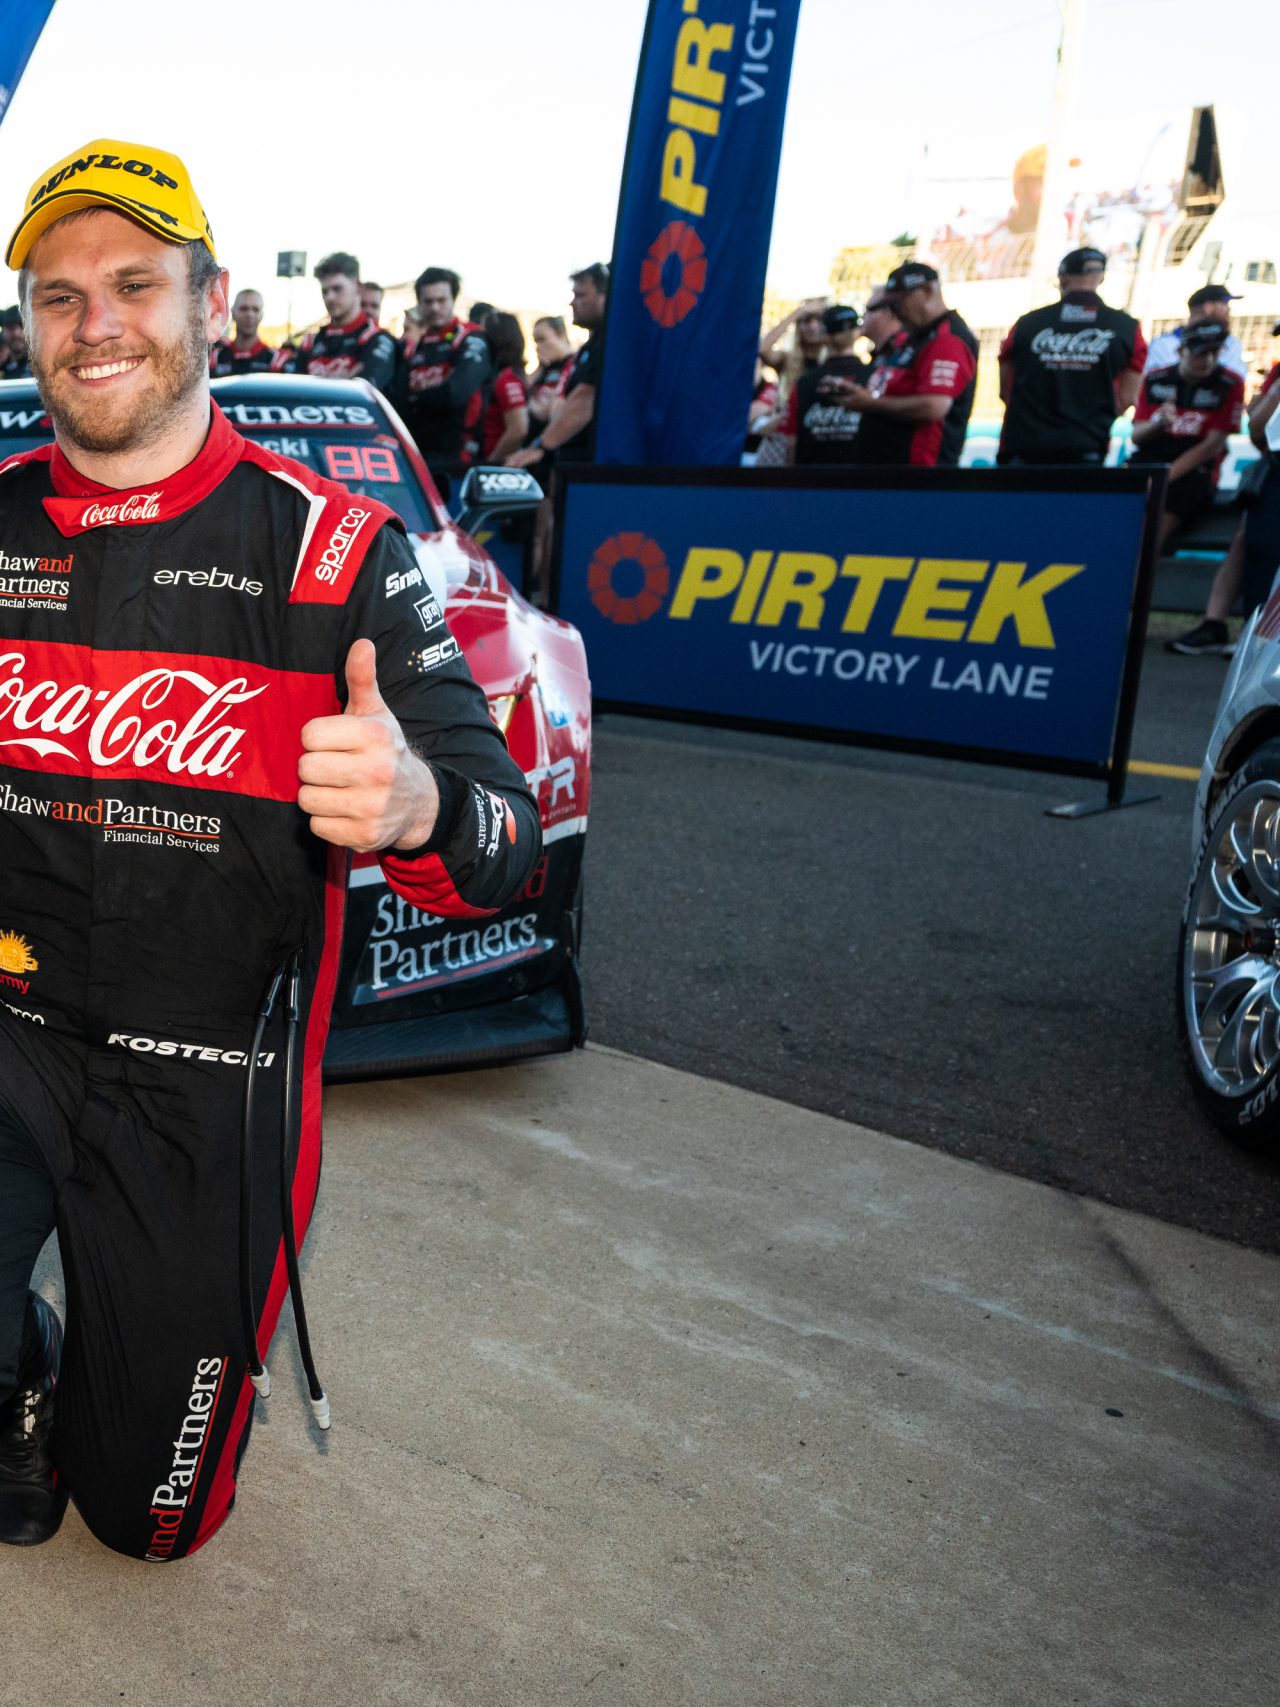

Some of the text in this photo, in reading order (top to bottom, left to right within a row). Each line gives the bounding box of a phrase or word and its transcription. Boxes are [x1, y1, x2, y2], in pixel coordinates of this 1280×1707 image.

[659, 0, 734, 216] PIR
[325, 446, 401, 483] 88
[81, 491, 163, 526] Coca-Cola
[315, 508, 365, 584] sparco
[28, 599, 67, 611] Services
[153, 567, 263, 596] erebus
[669, 547, 1086, 648] PIRTEK
[749, 640, 1054, 699] VICTORY LANE
[104, 830, 220, 853] Financial Services
[370, 913, 538, 990] Partners
